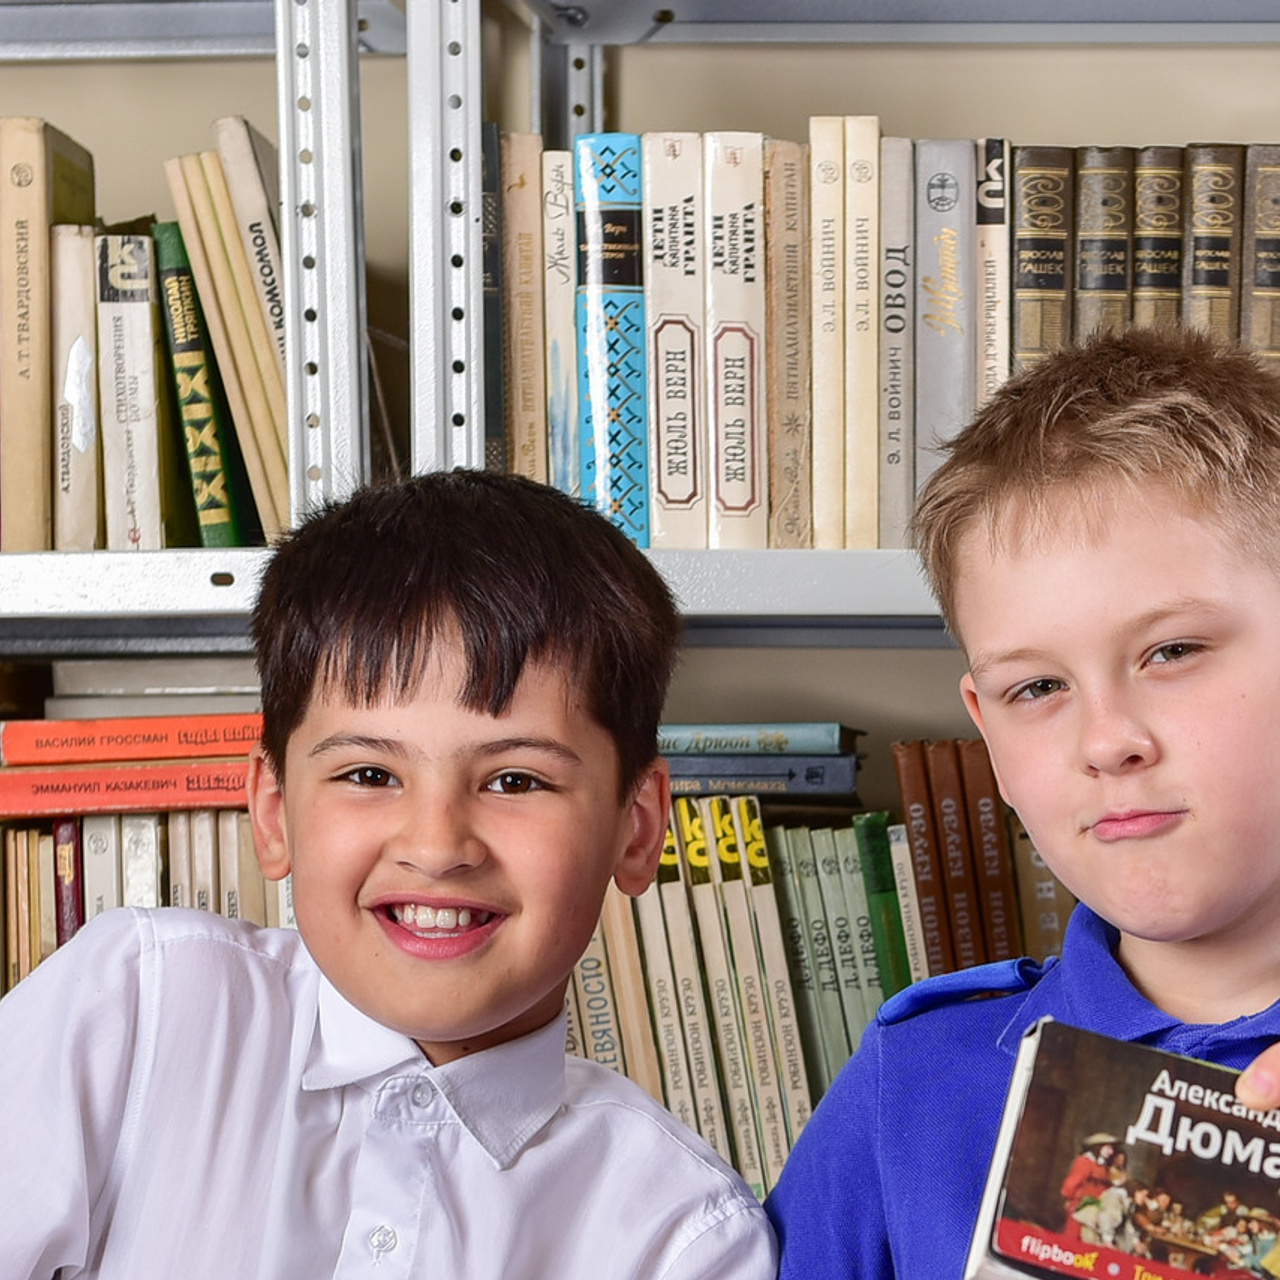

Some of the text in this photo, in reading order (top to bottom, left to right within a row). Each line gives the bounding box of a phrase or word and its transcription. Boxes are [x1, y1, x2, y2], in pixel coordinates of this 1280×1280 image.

[782, 161, 799, 232] КАПИТАН
[516, 231, 535, 287] КАПИТАН
[652, 207, 667, 266] ДЕТИ
[667, 205, 680, 268] КАПИТАНА
[682, 195, 696, 277] ГРАНТА
[711, 214, 727, 273] ДЕТИ
[727, 211, 741, 275] КАПИТАНА
[742, 202, 756, 284] ГРАНТА
[816, 218, 835, 292] ВОЙНИЧ
[850, 217, 869, 292] ВОЙНИЧ
[15, 219, 31, 343] ТВАРДОВСКИЙ
[247, 221, 287, 329] КОМСОМОЛ
[884, 244, 911, 335] ОВОД
[163, 275, 188, 344] НИКОЛАЙ
[782, 242, 800, 401] ПЯТНАДЦАТИЛЕТНИЙ
[112, 315, 129, 424] СТИХОТВОРЕНИЯ
[883, 346, 901, 421] ВОЙНИЧ
[664, 349, 689, 476] ЖЮЛЬ ВЕРН
[722, 356, 746, 482] ЖЮЛЬ ВЕРН
[35, 732, 170, 750] ВАСИЛИЙ ГРОССМАН
[31, 782, 102, 796] ЭММАНУИЛ
[104, 778, 178, 793] КАЗАКЕВИЧ
[908, 802, 933, 882] КРУЗО
[940, 798, 964, 880] КРУЗО
[977, 796, 1001, 878] КРУЗО
[811, 919, 834, 971] ДЕФО
[834, 916, 858, 970] ДЕФО
[856, 915, 879, 969] ДЕФО
[579, 957, 619, 1074] ЕВЯНОСТО
[679, 976, 698, 1018] КРУЗО
[714, 978, 731, 1018] КРУЗО
[742, 974, 761, 1015] КРУЗО
[773, 979, 791, 1019] КРУЗО
[655, 978, 685, 1091] РОБИНЗОН КРУЗО
[688, 1021, 710, 1089] РОБИНЗОН
[724, 1022, 744, 1090] РОБИНЗОН
[750, 1019, 772, 1087] РОБИНЗОН
[782, 1023, 803, 1091] РОБИНЗОН
[1021, 1235, 1099, 1272] flipbook
